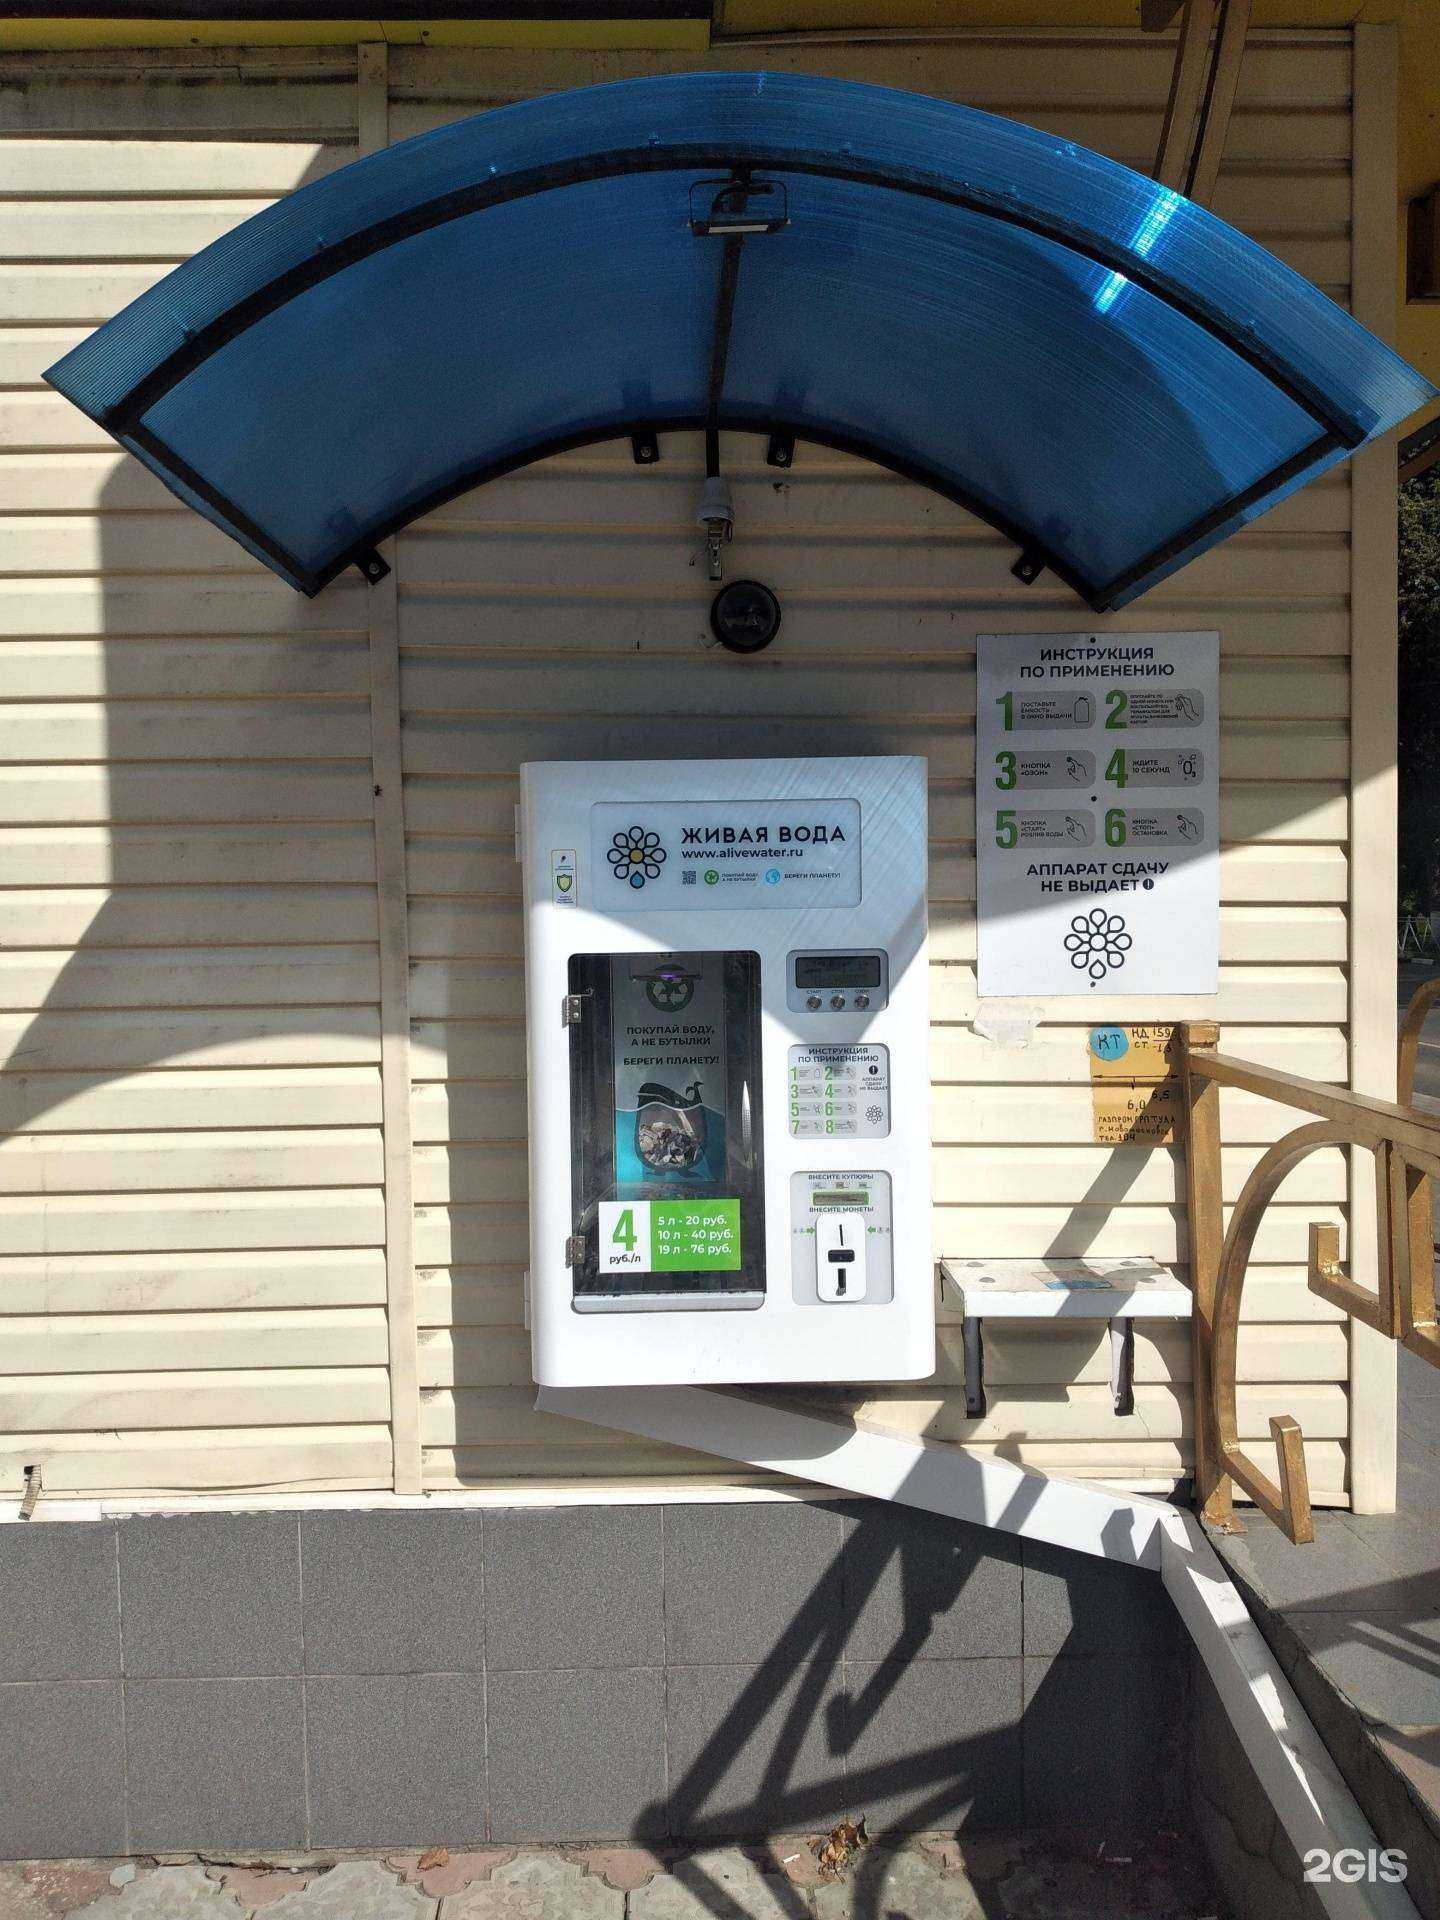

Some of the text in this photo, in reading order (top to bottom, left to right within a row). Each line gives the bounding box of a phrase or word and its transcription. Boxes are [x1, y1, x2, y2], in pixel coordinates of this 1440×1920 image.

[1040, 647, 1154, 662] ИНСТРУКЦИЯ
[1020, 663, 1175, 678] ПО ПРИМЕНЕНИЮ
[995, 691, 1013, 731] 1
[1105, 689, 1128, 729] 2
[1105, 748, 1129, 789] 4
[1132, 759, 1159, 767] ЖДИТЕ
[995, 751, 1017, 790] 3
[1142, 766, 1171, 775] СЕКУНД
[681, 825, 846, 845] ЖИВАЯ ВОДА
[995, 809, 1018, 849] 5
[1104, 808, 1127, 848] 6
[681, 847, 803, 860] www.alivewater.ru
[1027, 862, 1170, 877] АППАРАТ СДАЧУ
[1041, 880, 1064, 892] НЕ
[1068, 879, 1140, 893] ВЫДАЕТ
[627, 1025, 680, 1035] ПОКУПАЙ
[631, 1037, 711, 1046] А НЕ БУТЫЛКИ
[1098, 1034, 1120, 1051] КТ
[808, 1047, 869, 1055] ИНСТРУКЦИЯ
[624, 1056, 720, 1066] БЕРЕГИ ПЛАНЕТУ!
[813, 1055, 879, 1063] ПРИМЕНЕНИЮ
[790, 1067, 797, 1081] 1
[825, 1066, 833, 1080] 2
[791, 1084, 798, 1099] 3
[825, 1084, 834, 1098] 4
[791, 1102, 799, 1117] 5
[825, 1102, 833, 1116] 6
[791, 1120, 799, 1134] 7
[825, 1119, 834, 1134] 8
[657, 1216, 665, 1226] 5
[667, 1217, 676, 1226] л
[685, 1216, 700, 1225] 20
[703, 1215, 727, 1227] руб.
[612, 1209, 637, 1251] 4
[658, 1230, 670, 1240] 10
[691, 1229, 706, 1239] 40
[709, 1229, 733, 1241] руб.
[658, 1245, 670, 1254] 19
[672, 1246, 680, 1254] л
[690, 1244, 705, 1254] 76
[707, 1243, 732, 1255] руб.
[609, 1253, 641, 1265] руб./л
